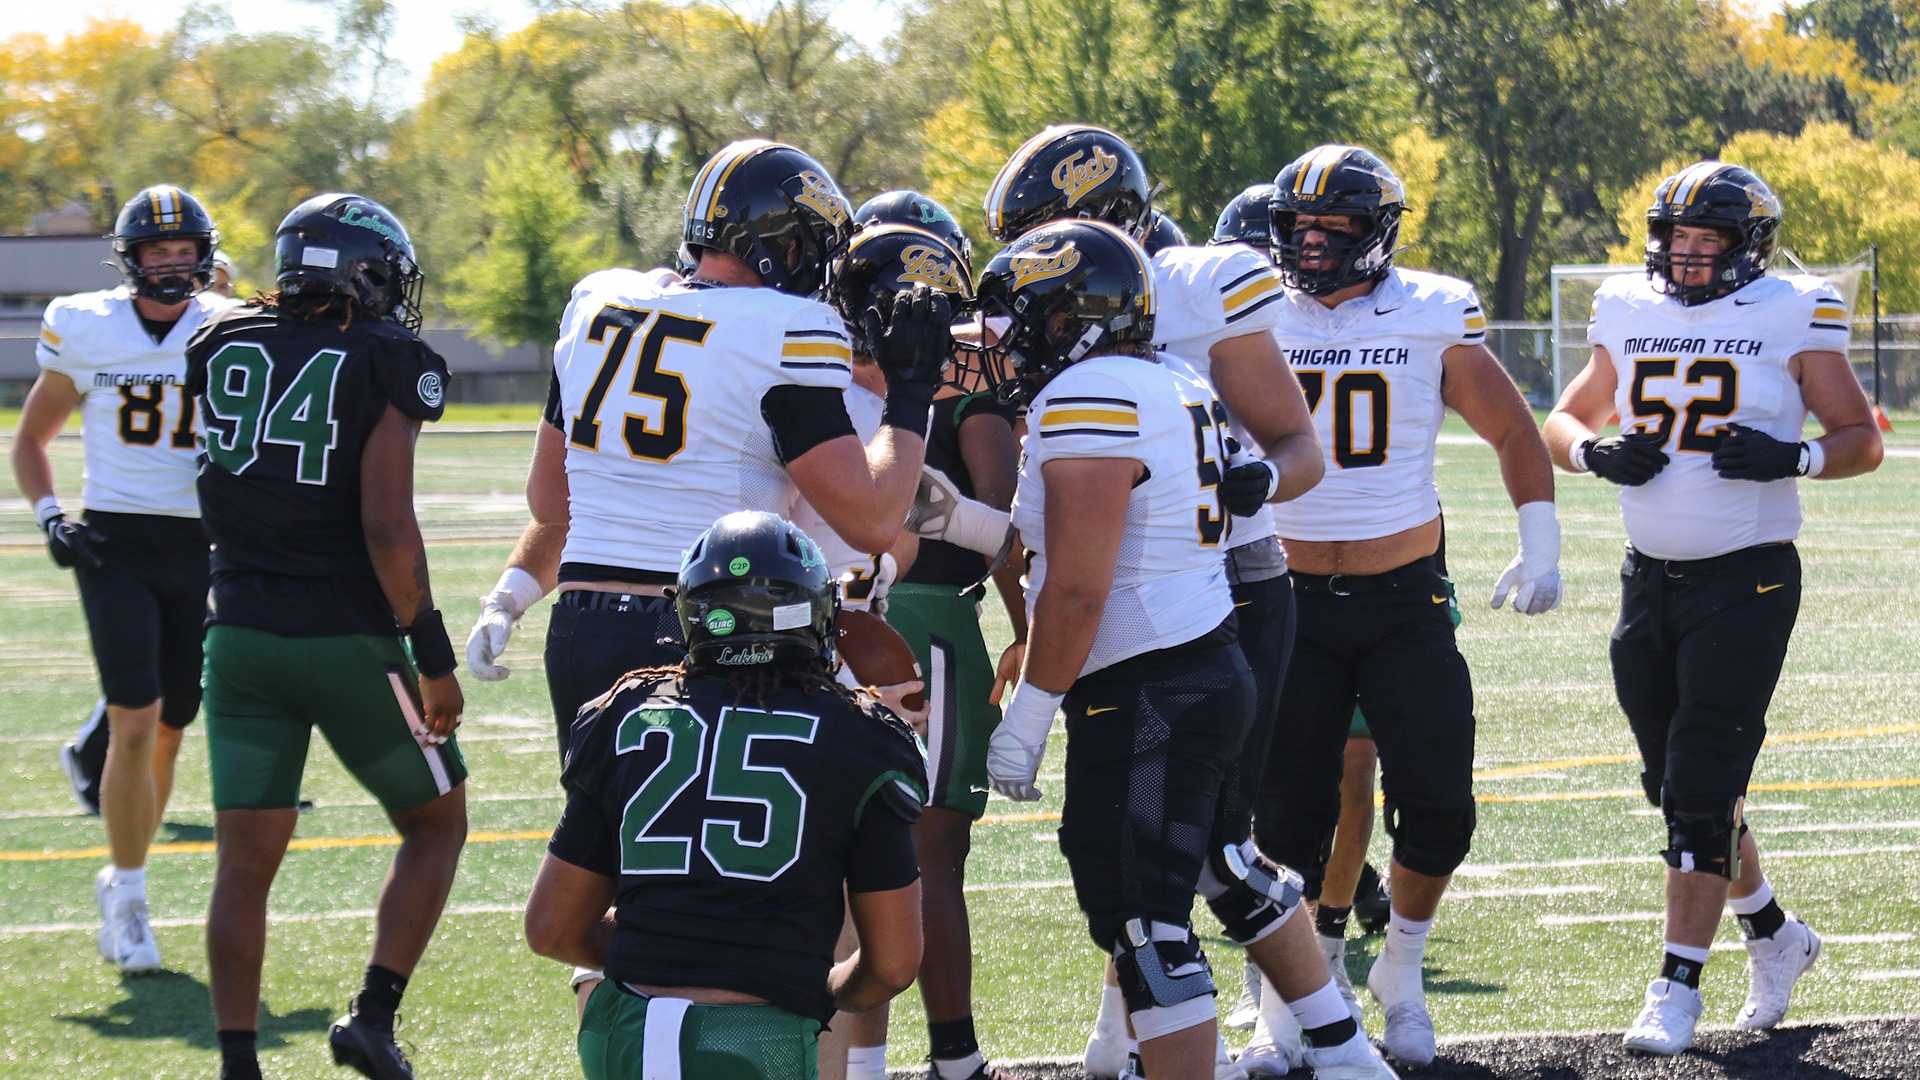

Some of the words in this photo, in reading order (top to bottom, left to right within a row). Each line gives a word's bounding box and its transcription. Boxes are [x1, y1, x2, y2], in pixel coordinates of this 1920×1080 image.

[1051, 145, 1117, 208] Tech
[339, 207, 402, 245] Lakers
[896, 245, 961, 293] Tech
[1010, 240, 1081, 292] Tech
[1359, 348, 1409, 365] TECH
[1624, 337, 1706, 356] MICHIGAN
[1712, 339, 1763, 356] TECH
[94, 373, 176, 387] MICHIGAN
[569, 302, 717, 464] 75
[116, 384, 198, 450] 81
[206, 341, 347, 487] 94
[1628, 357, 1739, 455] 52
[730, 562, 748, 570] C2P
[709, 620, 733, 630] GLIAC
[717, 646, 774, 665] Lakers
[615, 703, 820, 882] 25
